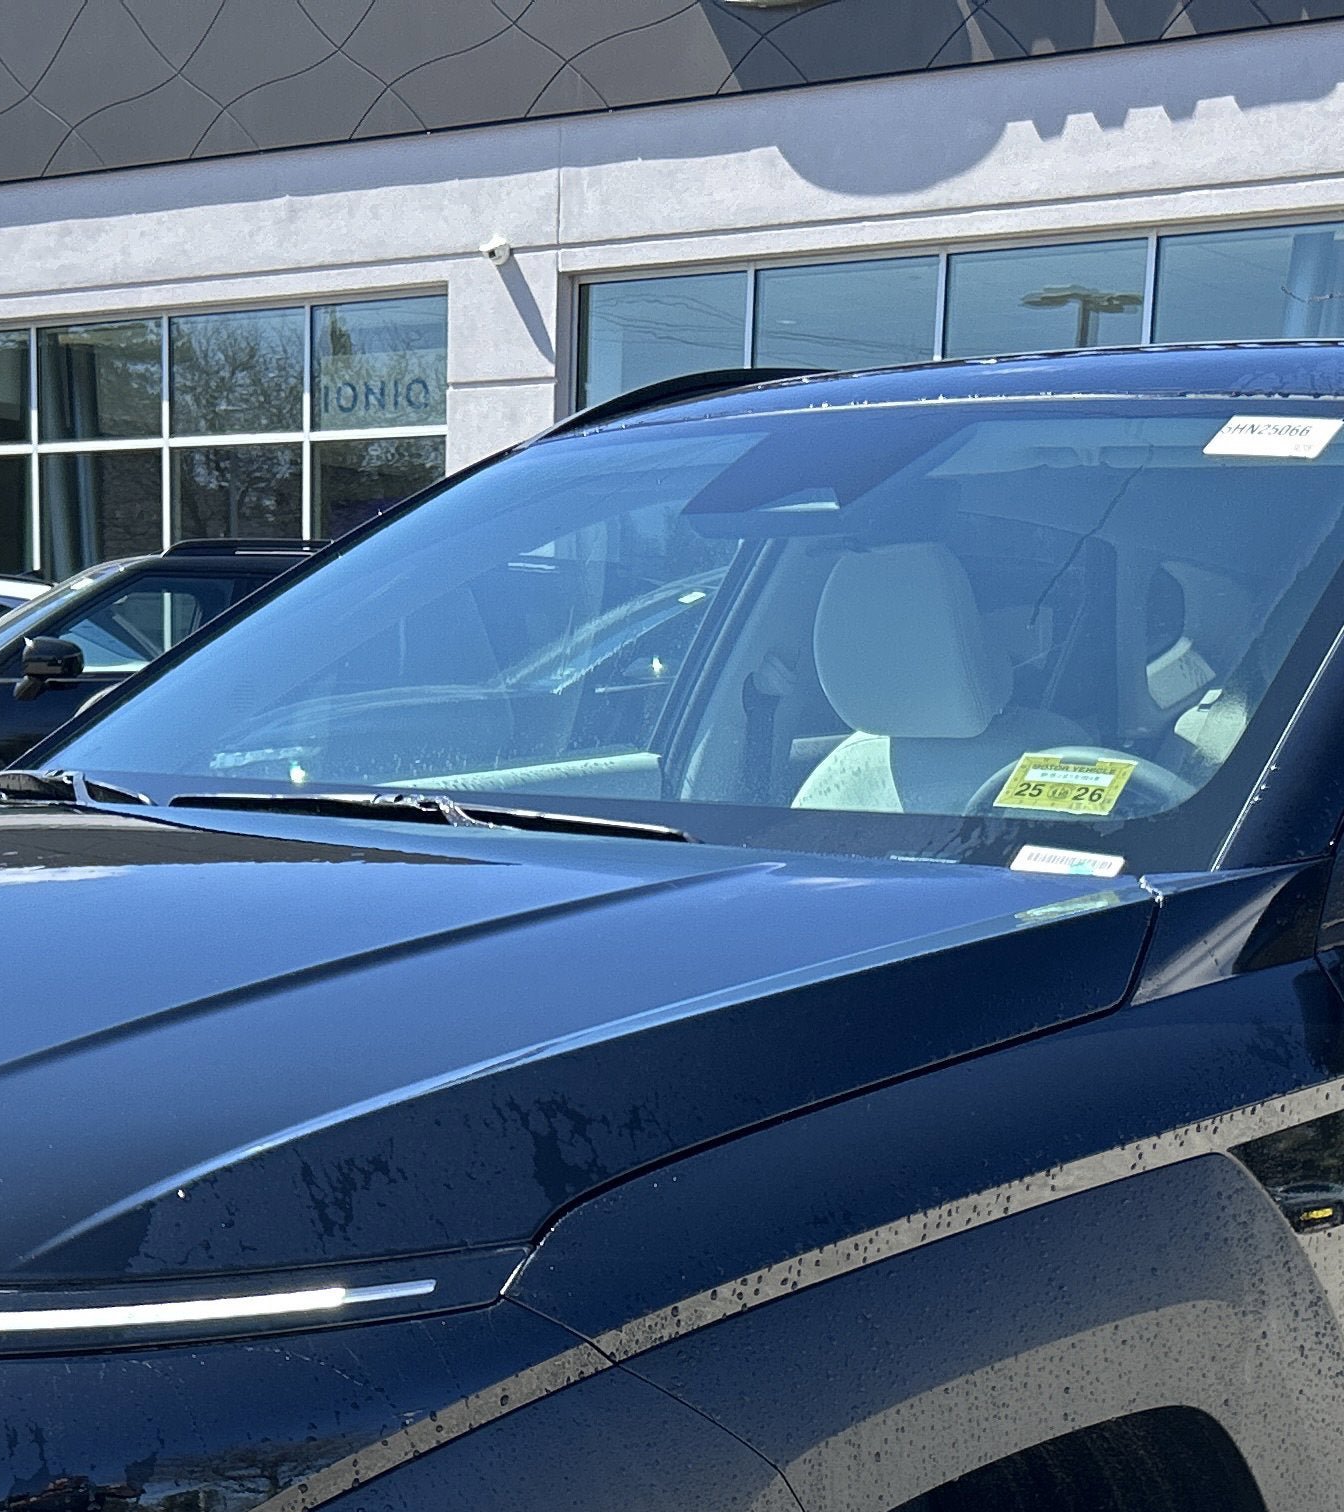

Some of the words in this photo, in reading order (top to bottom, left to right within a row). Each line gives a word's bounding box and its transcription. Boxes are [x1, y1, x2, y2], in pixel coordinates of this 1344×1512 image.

[323, 378, 430, 413] IONIQ
[1014, 782, 1045, 798] 25
[1071, 786, 1105, 803] 26
